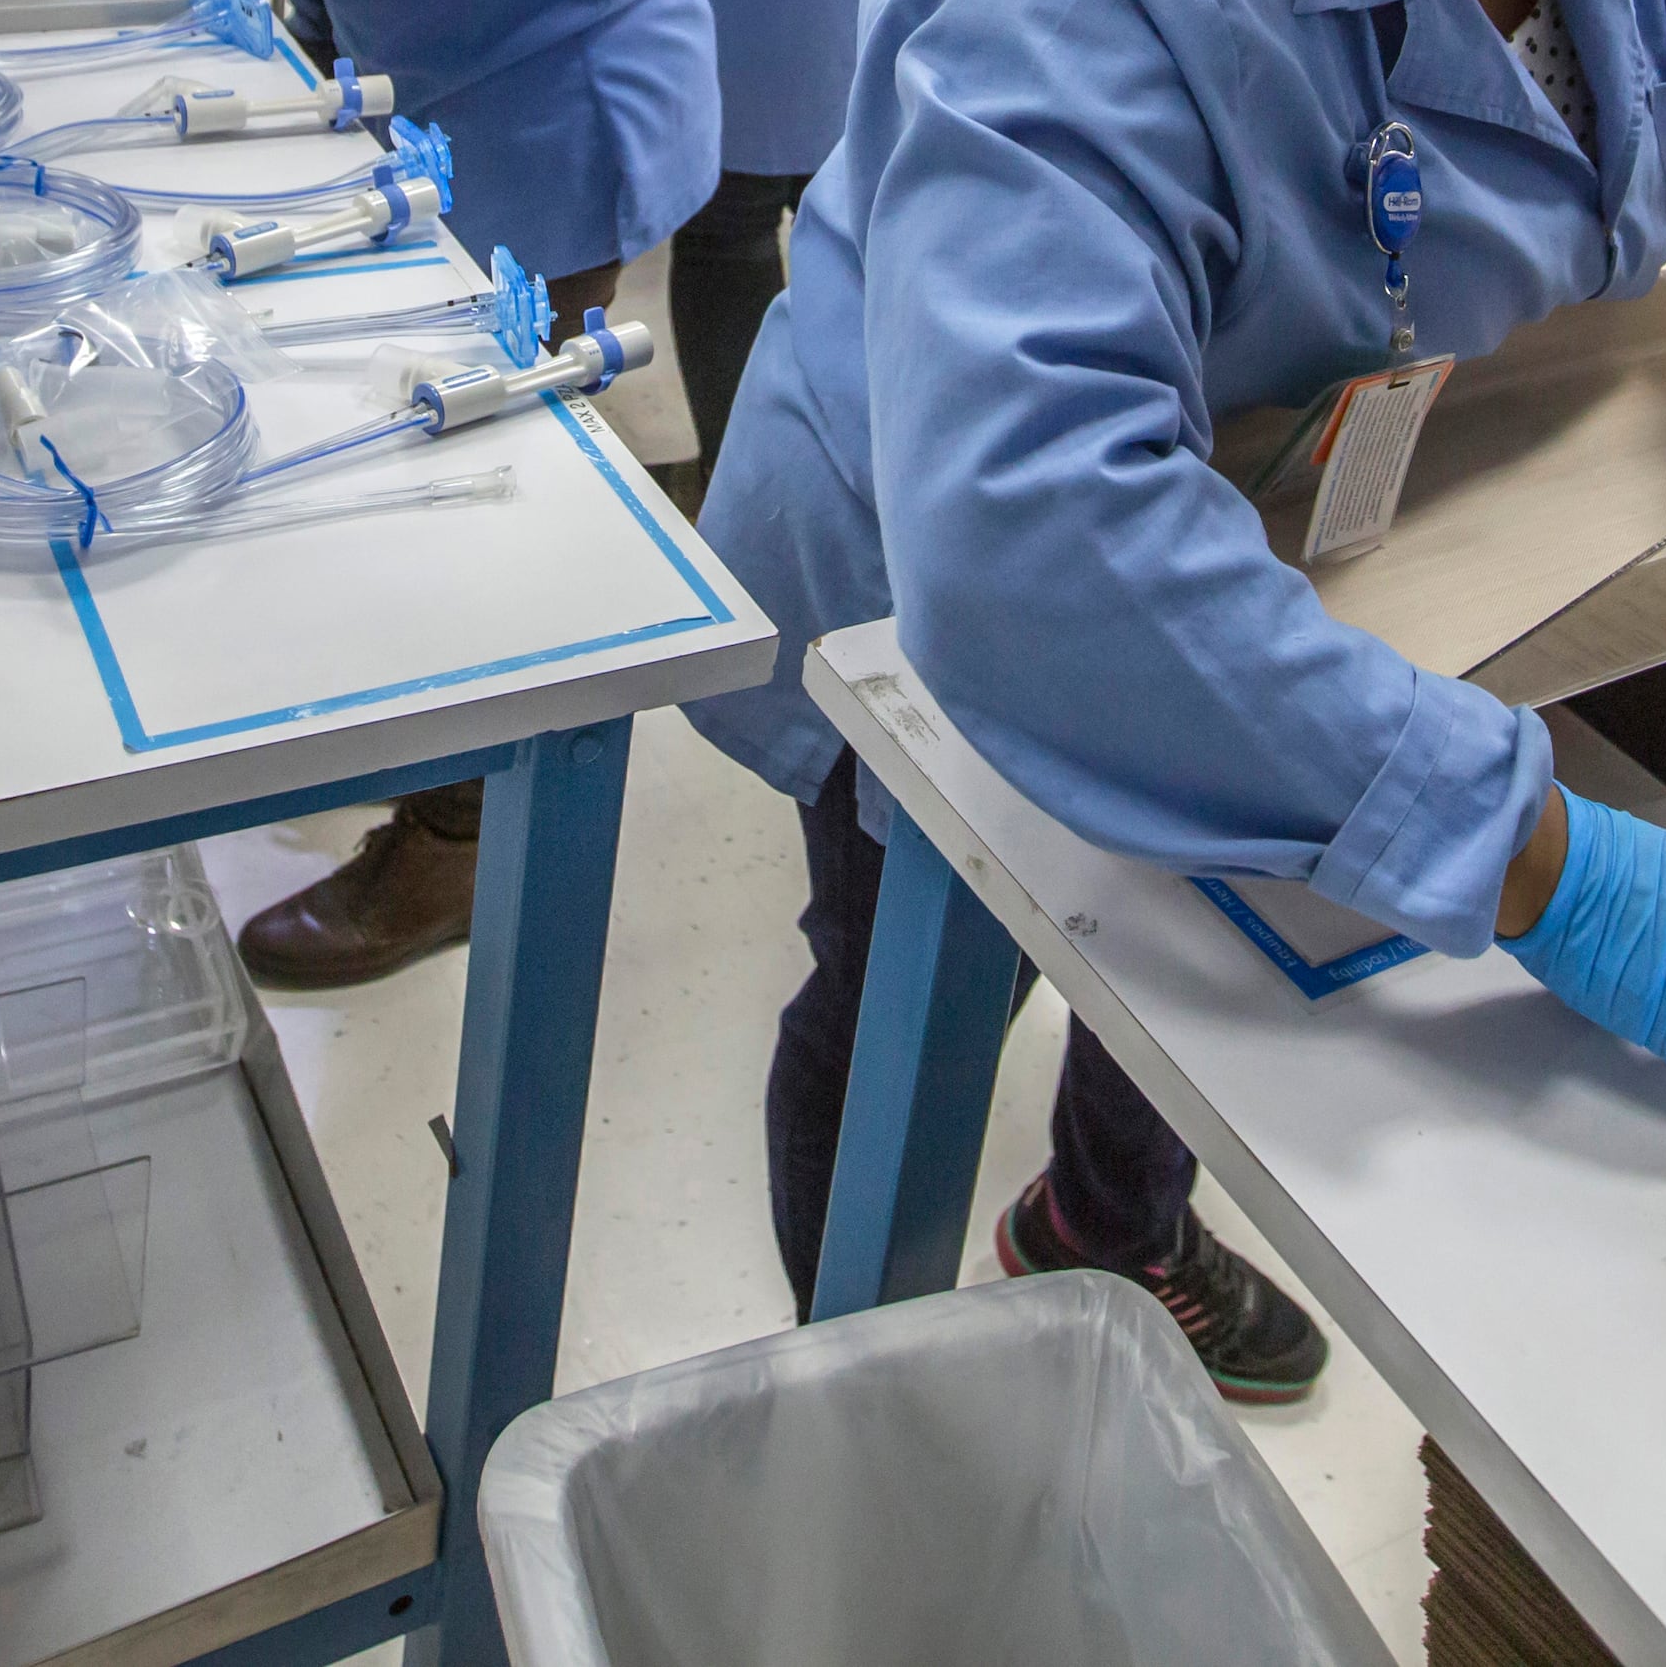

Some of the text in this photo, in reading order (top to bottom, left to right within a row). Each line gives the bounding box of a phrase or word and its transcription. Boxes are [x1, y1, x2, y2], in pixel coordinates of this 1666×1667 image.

[569, 401, 582, 413] 2
[579, 408, 607, 434] MAX
[1327, 951, 1389, 982] Equipos
